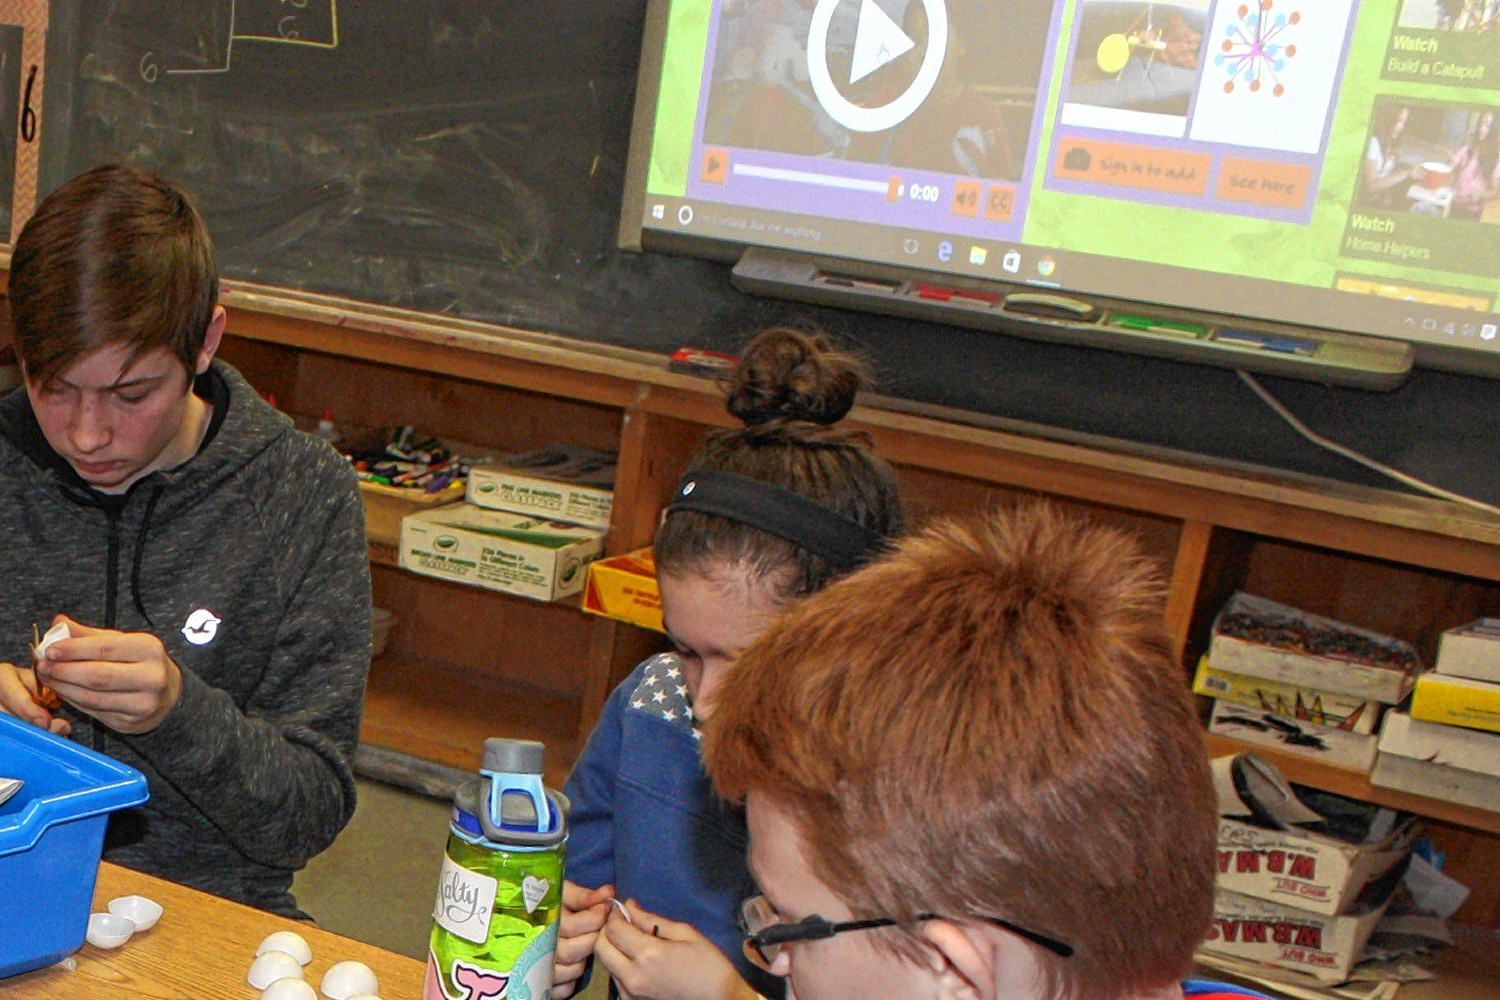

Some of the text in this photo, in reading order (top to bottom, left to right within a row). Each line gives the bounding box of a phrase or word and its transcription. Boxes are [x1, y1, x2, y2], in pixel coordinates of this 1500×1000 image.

[1393, 35, 1438, 53] Watch
[140, 52, 158, 83] 6
[1387, 57, 1486, 81] Build a Catapult
[20, 64, 38, 143] 6
[909, 183, 939, 202] 0:00
[1352, 214, 1395, 233] Watch
[1346, 236, 1382, 254] Home
